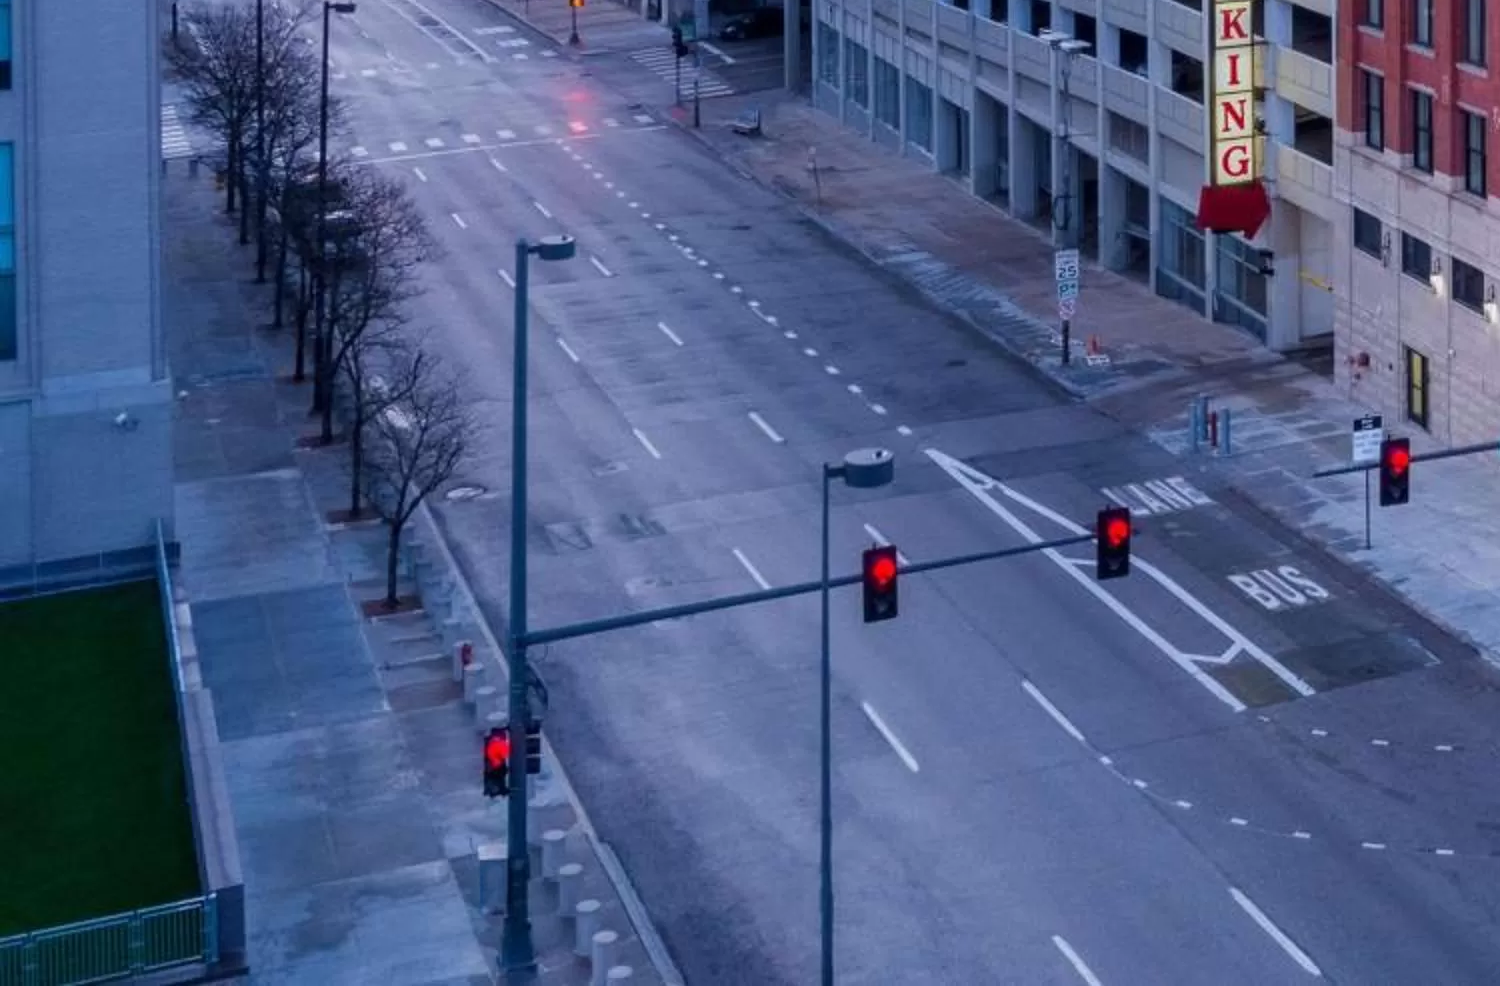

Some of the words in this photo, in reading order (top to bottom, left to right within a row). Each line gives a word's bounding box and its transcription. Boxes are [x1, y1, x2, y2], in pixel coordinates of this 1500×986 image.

[1058, 265, 1077, 279] 25
[1101, 475, 1214, 515] LANE
[1227, 565, 1329, 610] BUS
